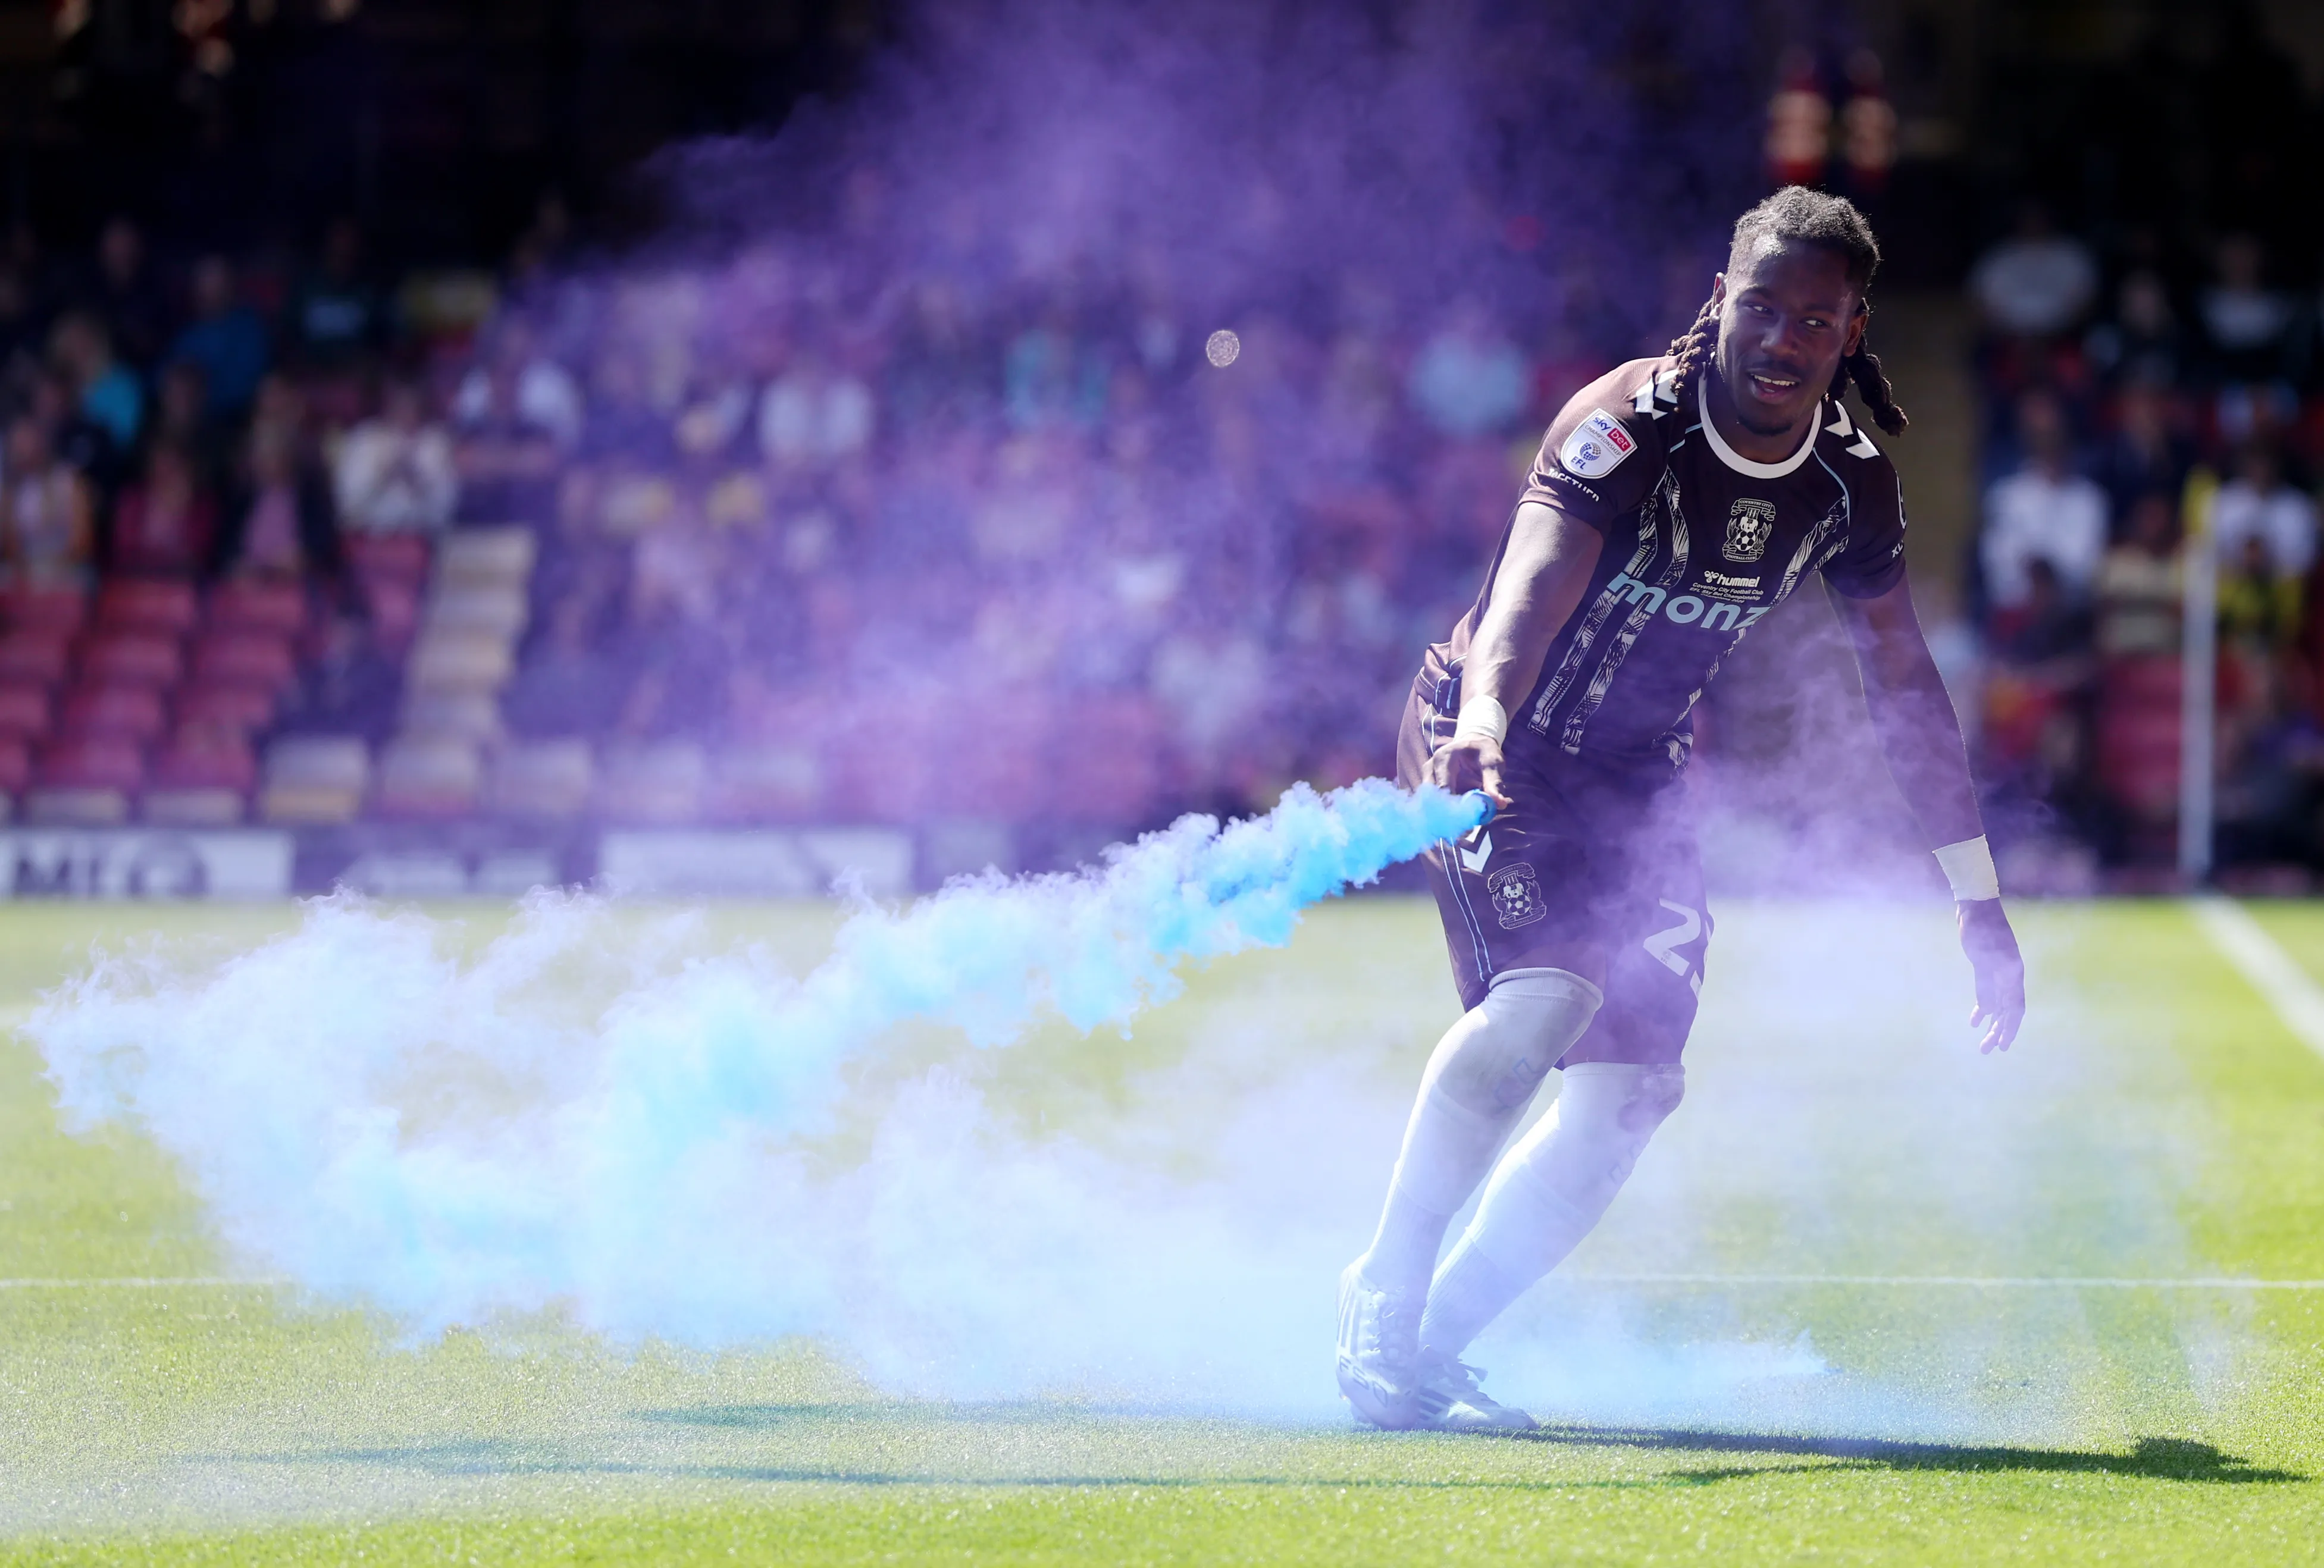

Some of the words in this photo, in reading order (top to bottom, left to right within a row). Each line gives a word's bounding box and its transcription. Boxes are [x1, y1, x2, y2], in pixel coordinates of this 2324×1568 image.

[1592, 417, 1611, 431] sky
[1611, 430, 1628, 449] bet
[1584, 424, 1621, 456] CHAMPIONSHIP
[1571, 456, 1587, 469] EFL
[1693, 582, 1718, 591] Coventry
[1717, 574, 1760, 587] hummel
